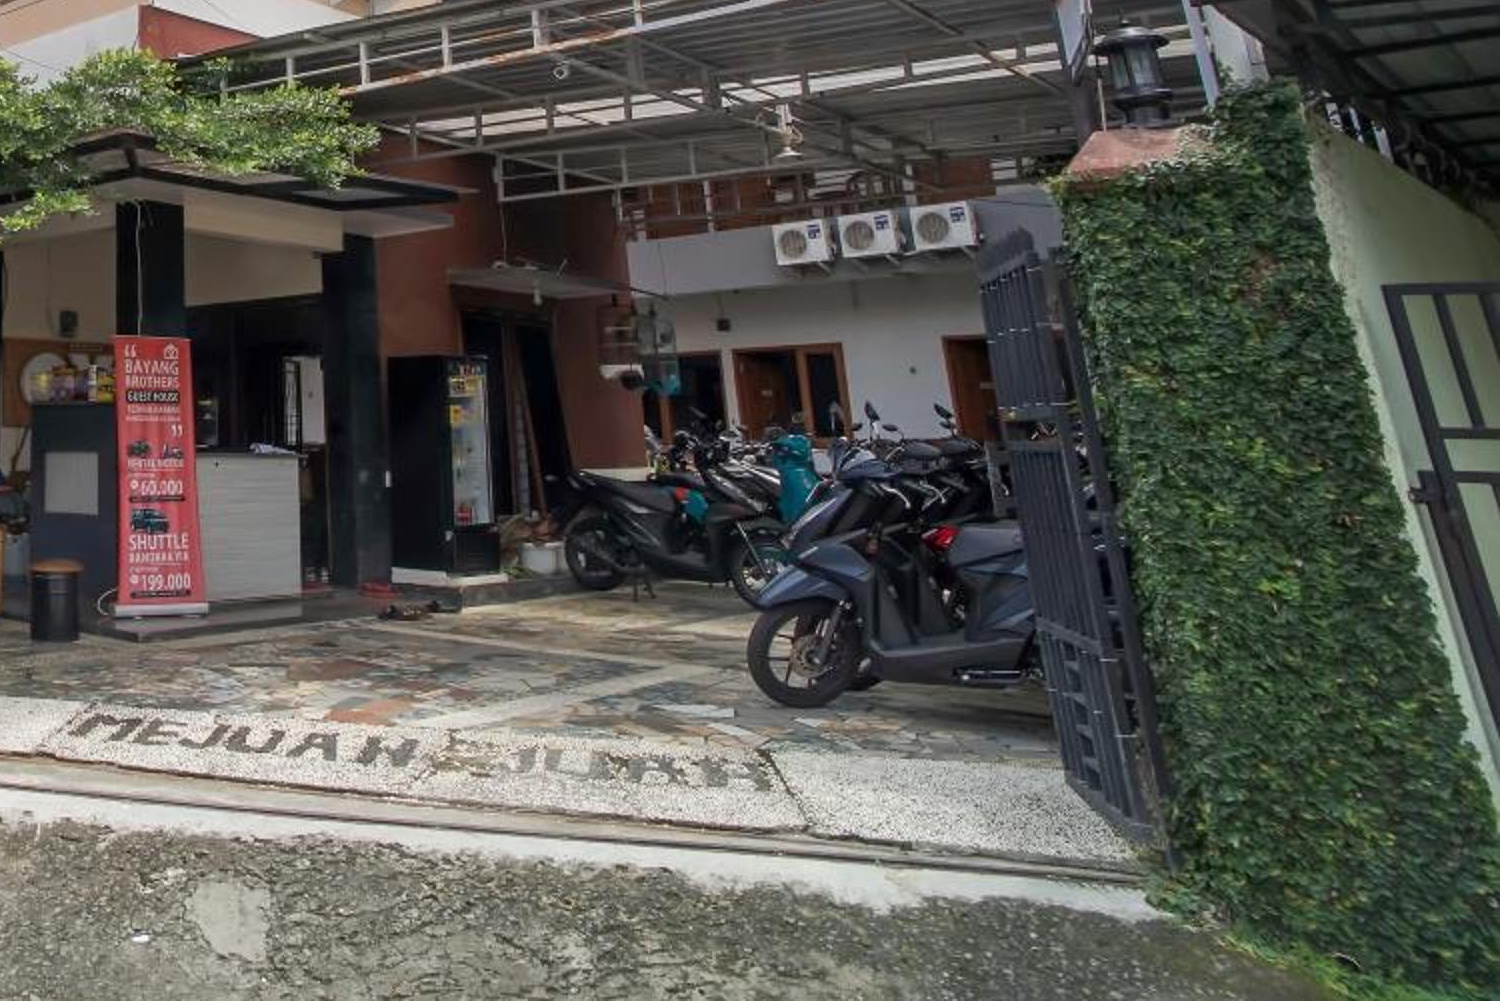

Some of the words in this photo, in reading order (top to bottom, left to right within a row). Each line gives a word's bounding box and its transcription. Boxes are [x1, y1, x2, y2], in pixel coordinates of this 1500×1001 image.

[124, 359, 179, 375] BAYANG
[124, 375, 180, 390] BROTHERS
[141, 479, 184, 496] 60.000
[128, 533, 189, 550] SHUTTLE
[141, 573, 191, 591] 199.000
[67, 711, 419, 769] MEJUAH
